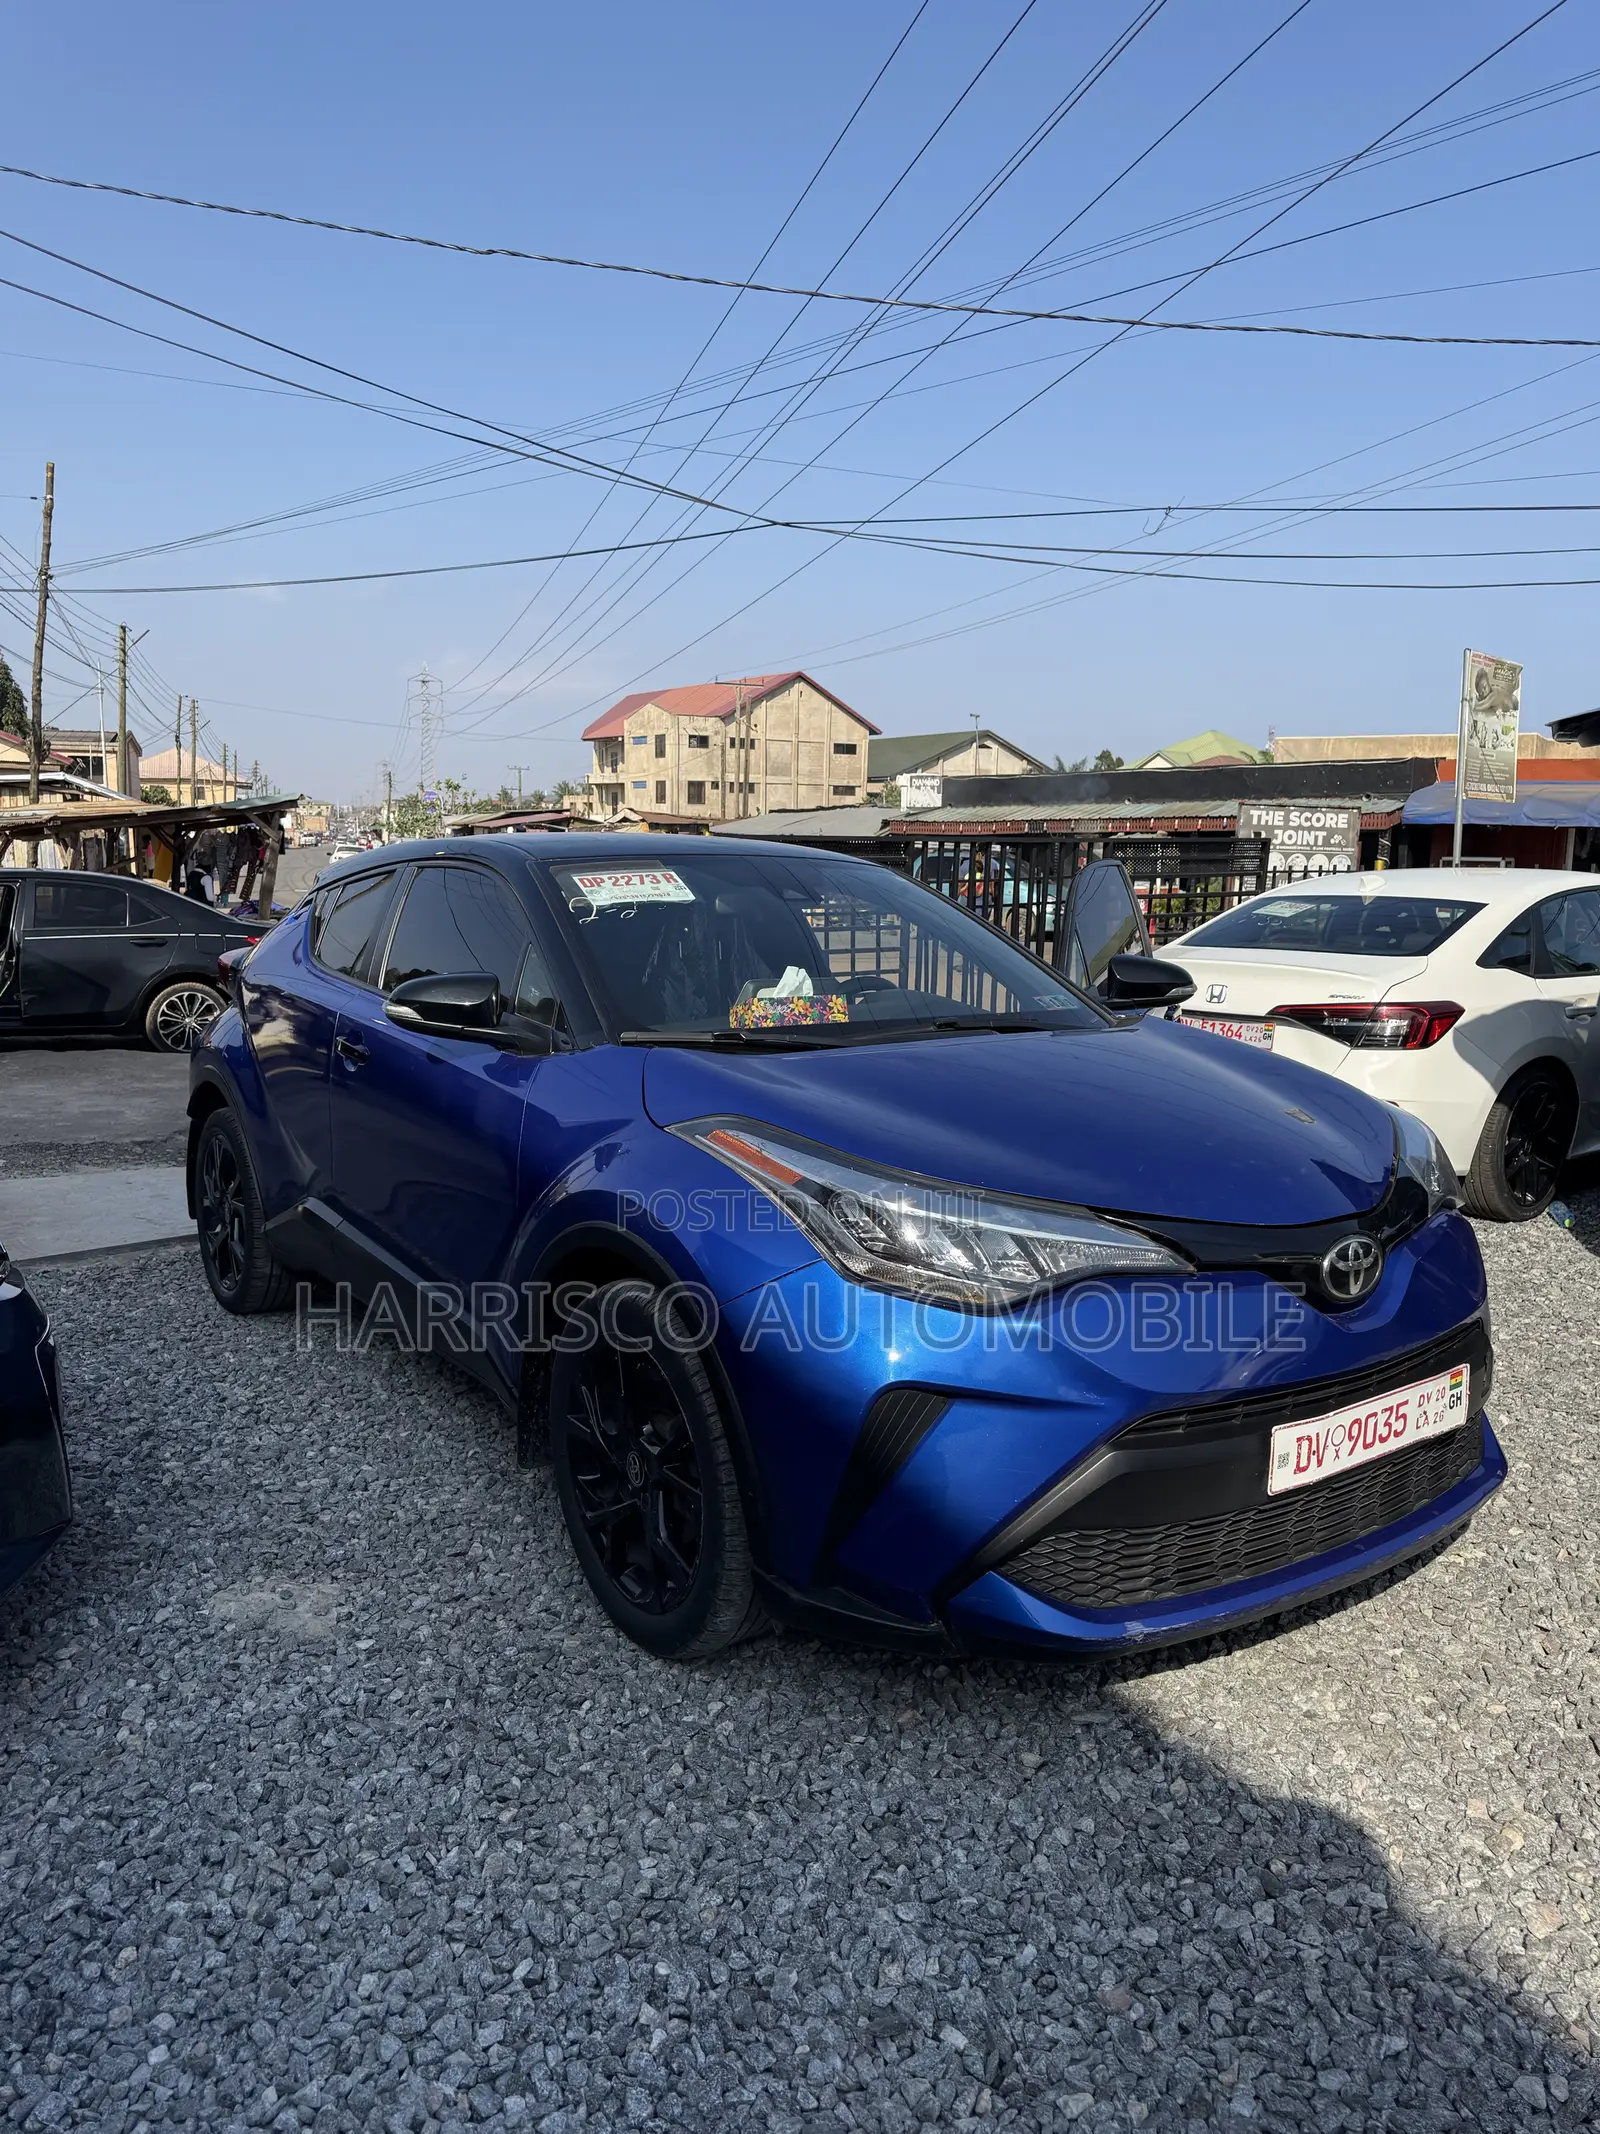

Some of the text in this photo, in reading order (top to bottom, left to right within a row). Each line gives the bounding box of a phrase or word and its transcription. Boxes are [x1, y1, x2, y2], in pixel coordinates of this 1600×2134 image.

[1249, 810, 1349, 829] THE SCORE
[1272, 829, 1327, 846] JOINT
[578, 871, 679, 889] DP 2273 R
[1262, 1033, 1272, 1041] GH
[1448, 1390, 1463, 1410] GH
[1293, 1399, 1410, 1475] DV 9035
